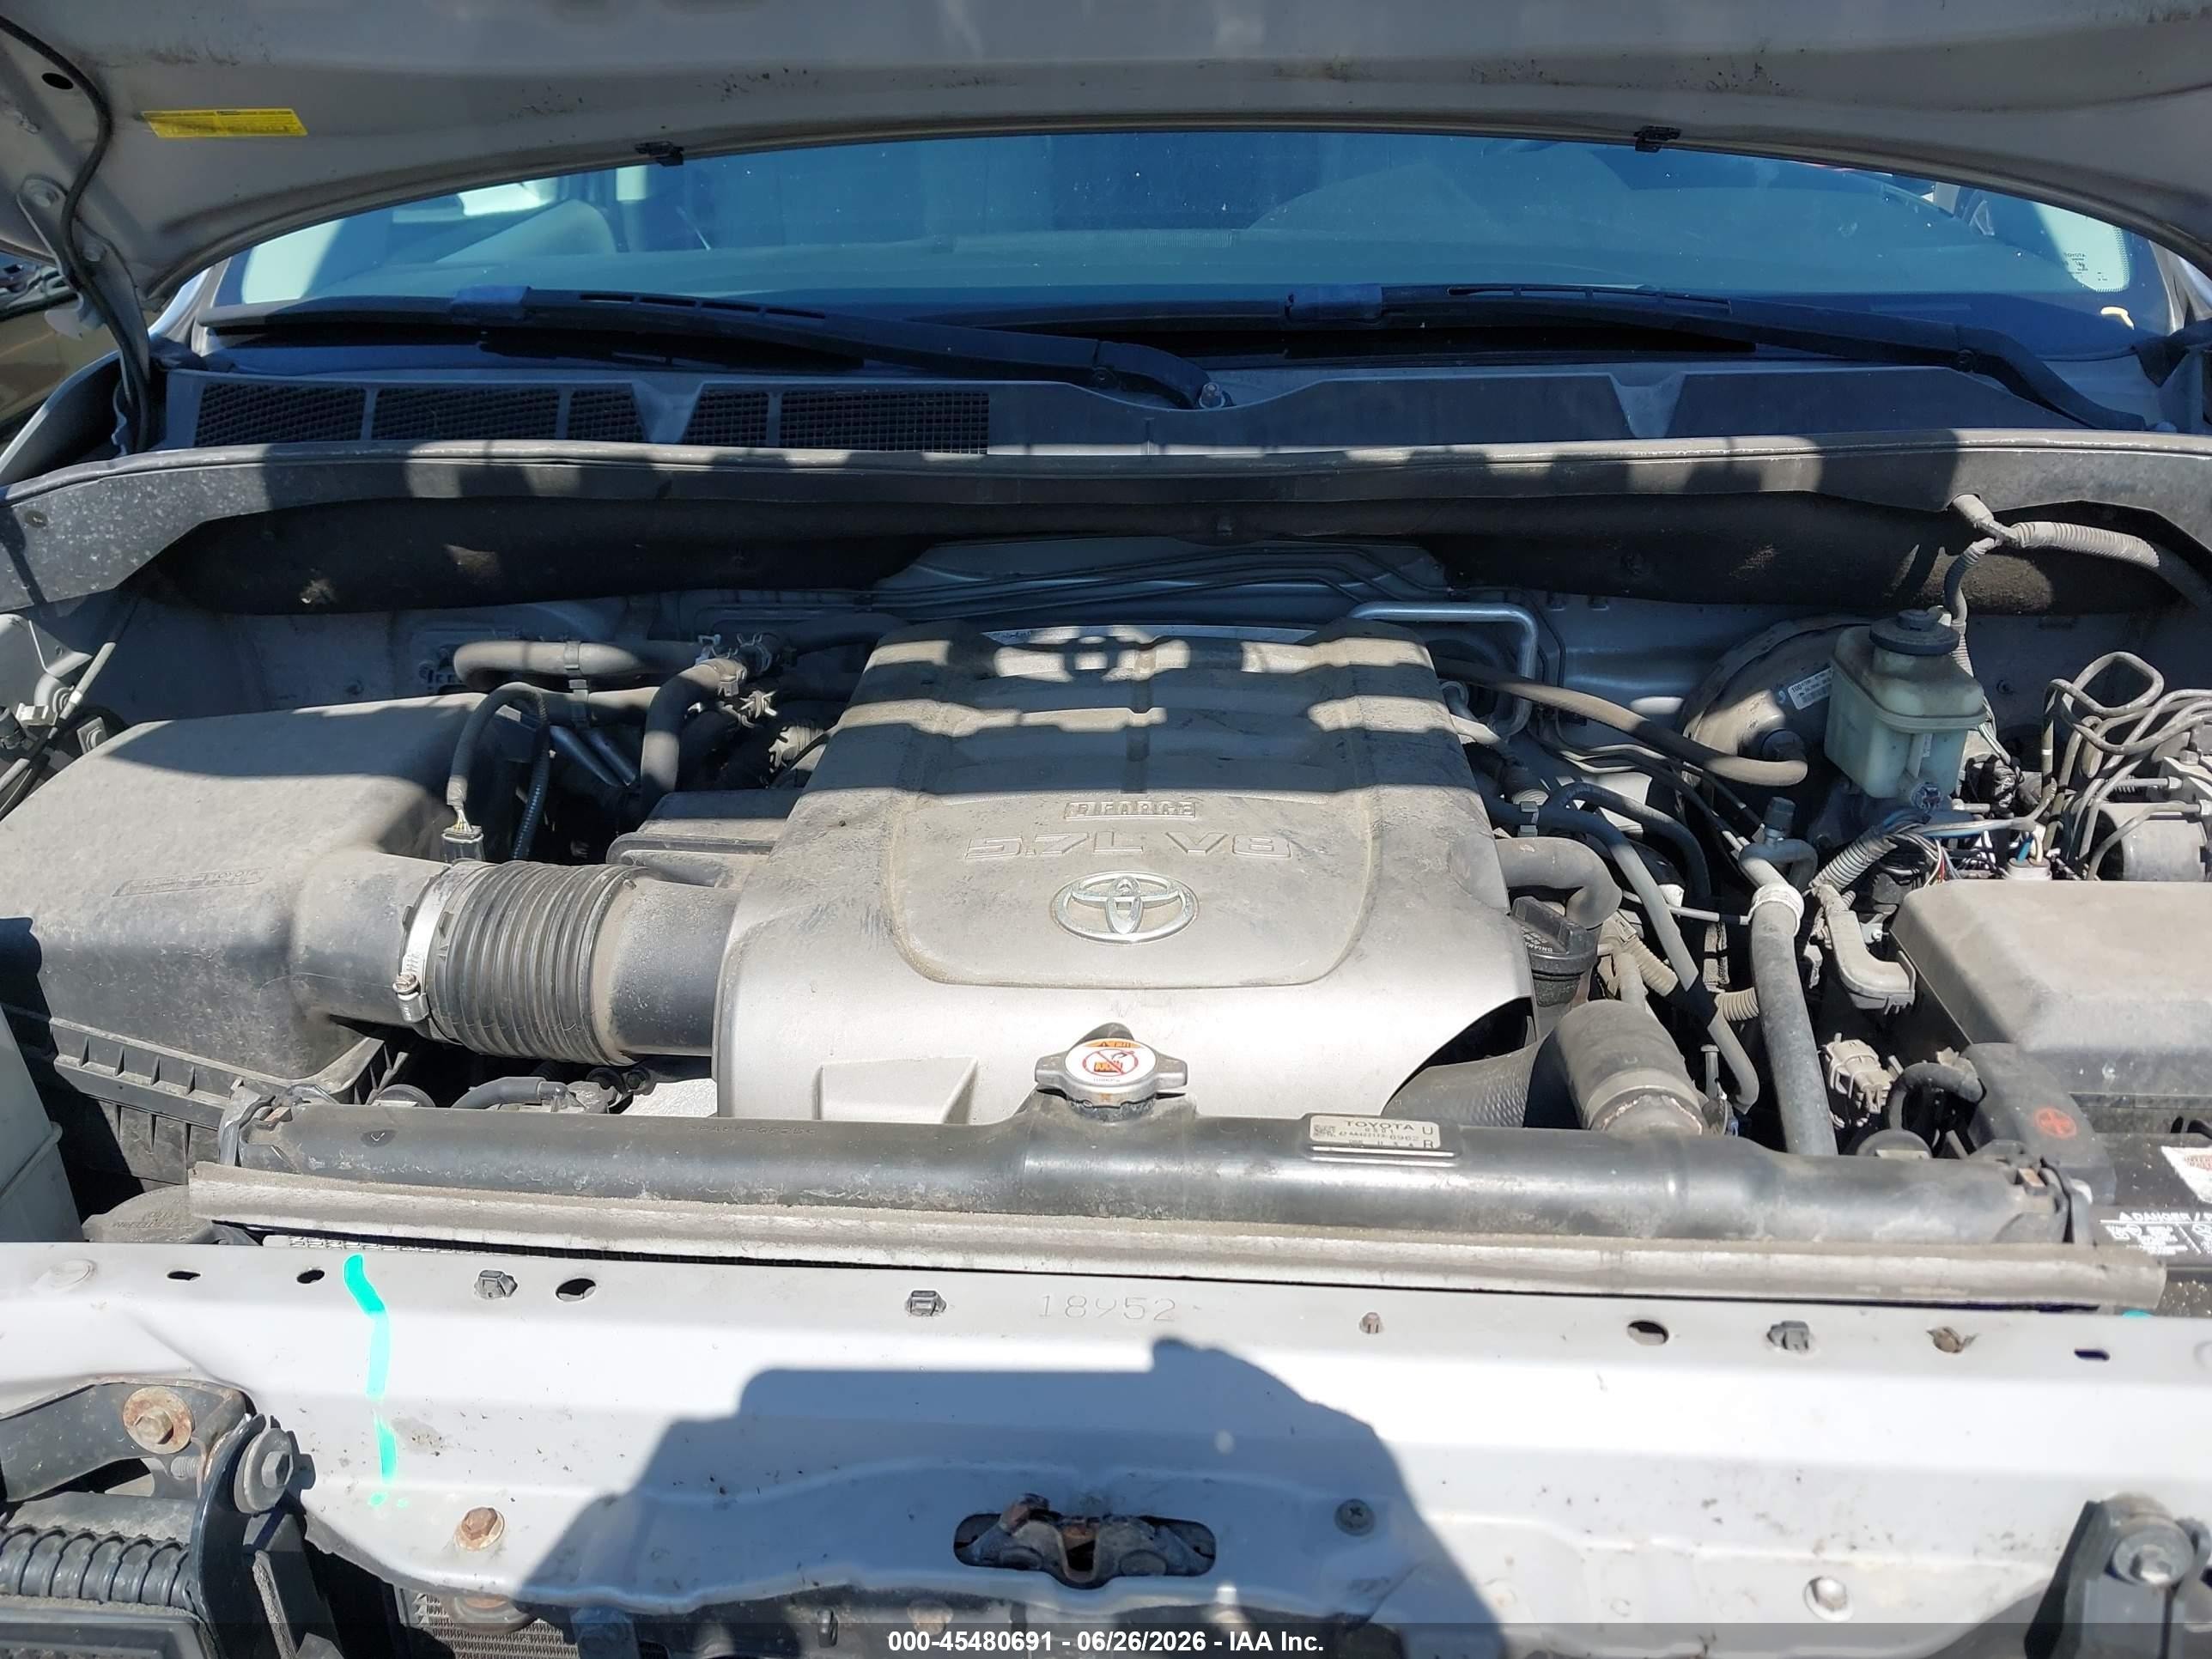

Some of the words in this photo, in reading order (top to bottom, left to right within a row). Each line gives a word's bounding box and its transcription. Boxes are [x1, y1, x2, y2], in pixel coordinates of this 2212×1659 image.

[964, 831, 1144, 859] 5.7L
[1165, 831, 1292, 859] V8
[1346, 1121, 1414, 1131] TOYOTA
[1422, 1127, 1433, 1135] U
